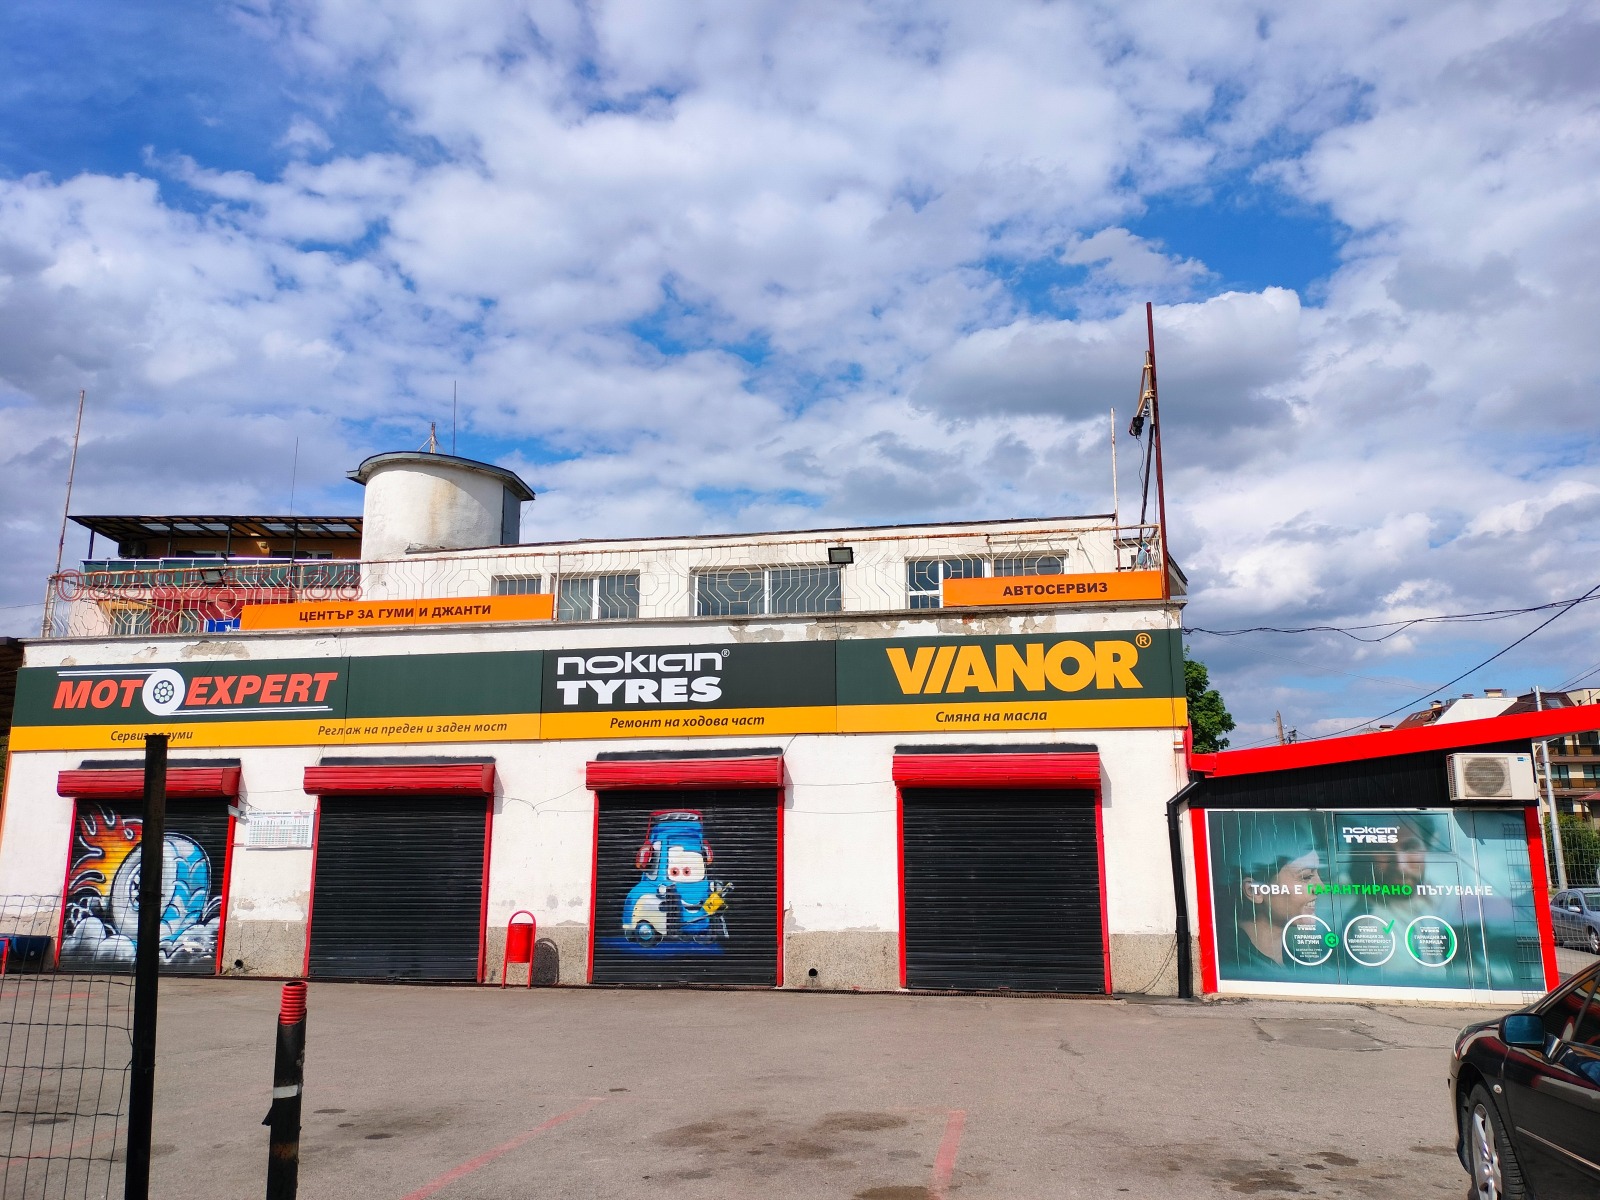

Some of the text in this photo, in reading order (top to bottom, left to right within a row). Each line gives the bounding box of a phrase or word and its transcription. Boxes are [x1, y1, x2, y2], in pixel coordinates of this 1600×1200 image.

[1002, 582, 1108, 597] АВТОСЕРВИЗ
[299, 604, 492, 623] ЦЕНТЪР ЗА ГУМИ И ДЖАНТИ
[885, 640, 1144, 695] VIANOR
[556, 676, 723, 706] TYRES
[610, 715, 765, 730] Ремонт на ходова част
[935, 711, 1048, 724] Смяна на масла
[317, 722, 508, 737] Реглаж на преден и заден мост
[1342, 834, 1399, 844] TYRES
[1251, 884, 1494, 897] ТОВА Е ГАРАНТИРАНО ПЪТУВАНЕ
